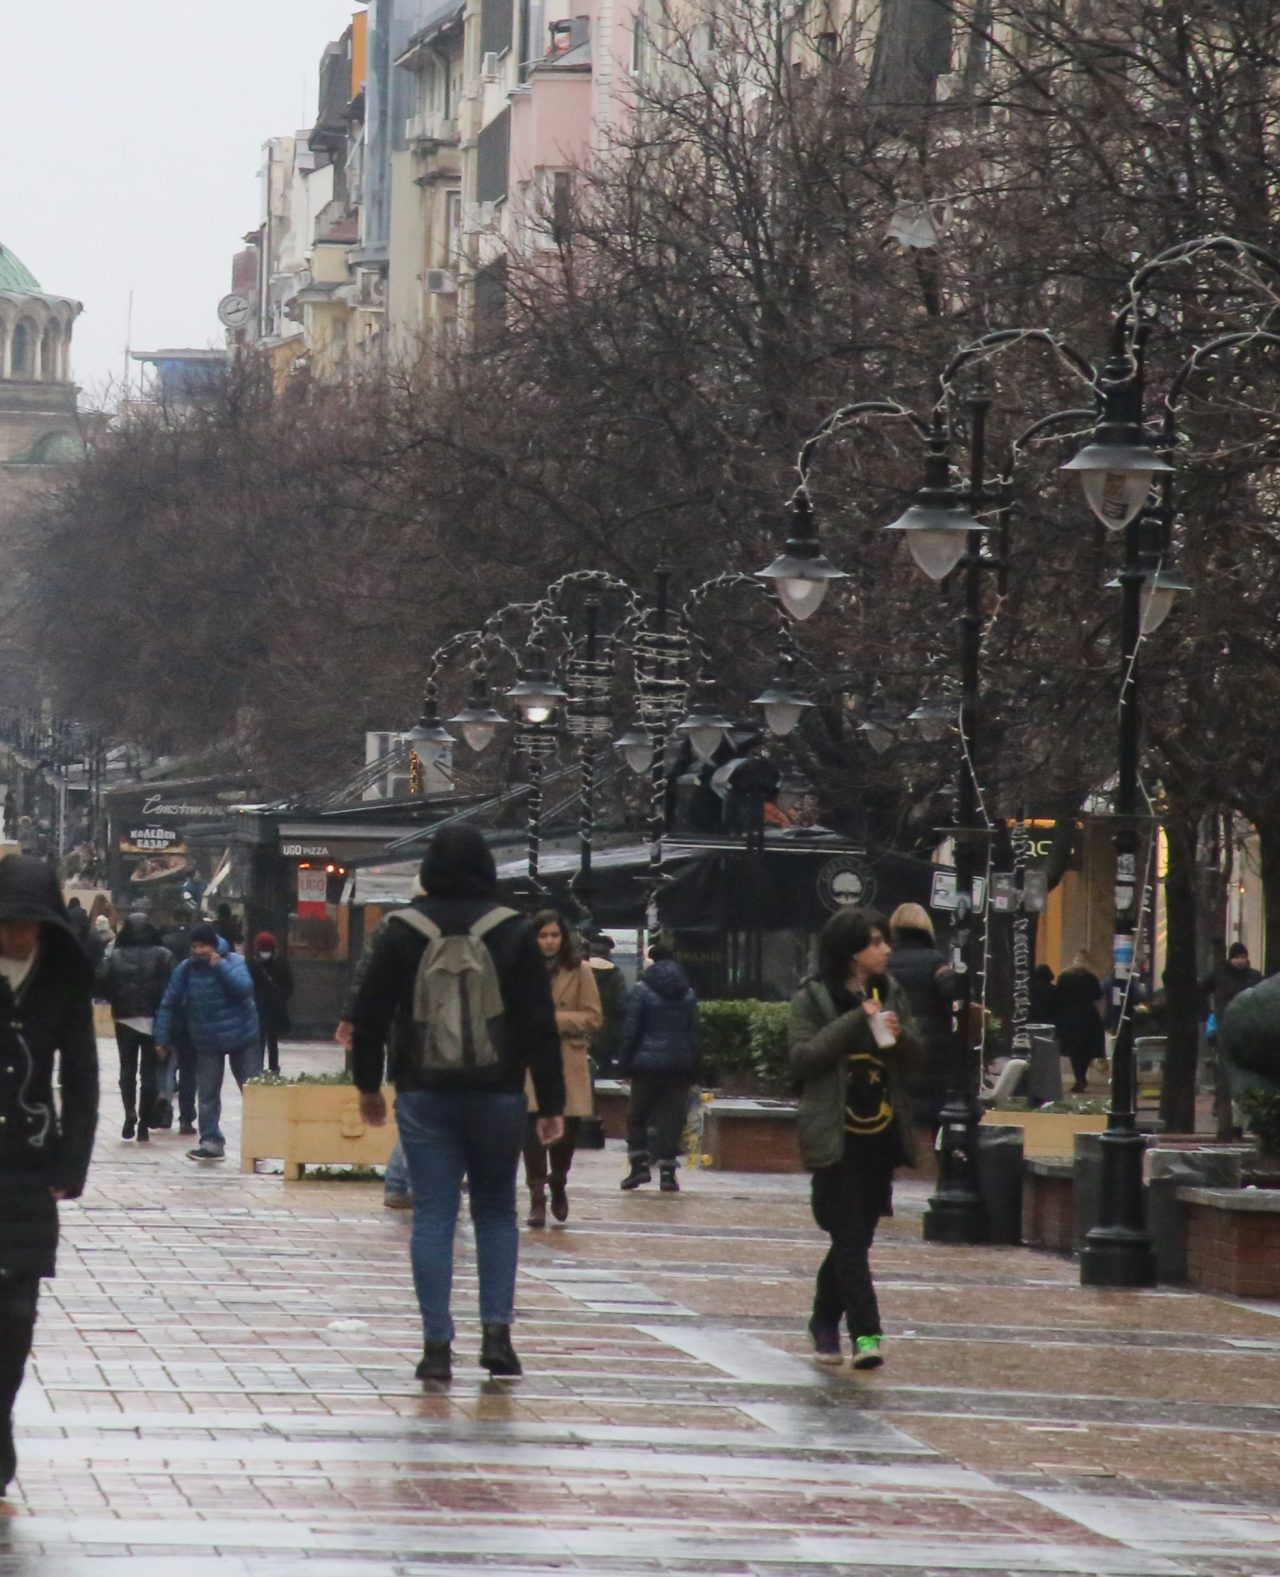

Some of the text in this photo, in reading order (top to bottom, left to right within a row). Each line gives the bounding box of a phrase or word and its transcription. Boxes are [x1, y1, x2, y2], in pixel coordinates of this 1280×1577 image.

[137, 839, 169, 849] БАЗАР
[283, 845, 302, 855] UGO
[301, 879, 324, 891] UGO
